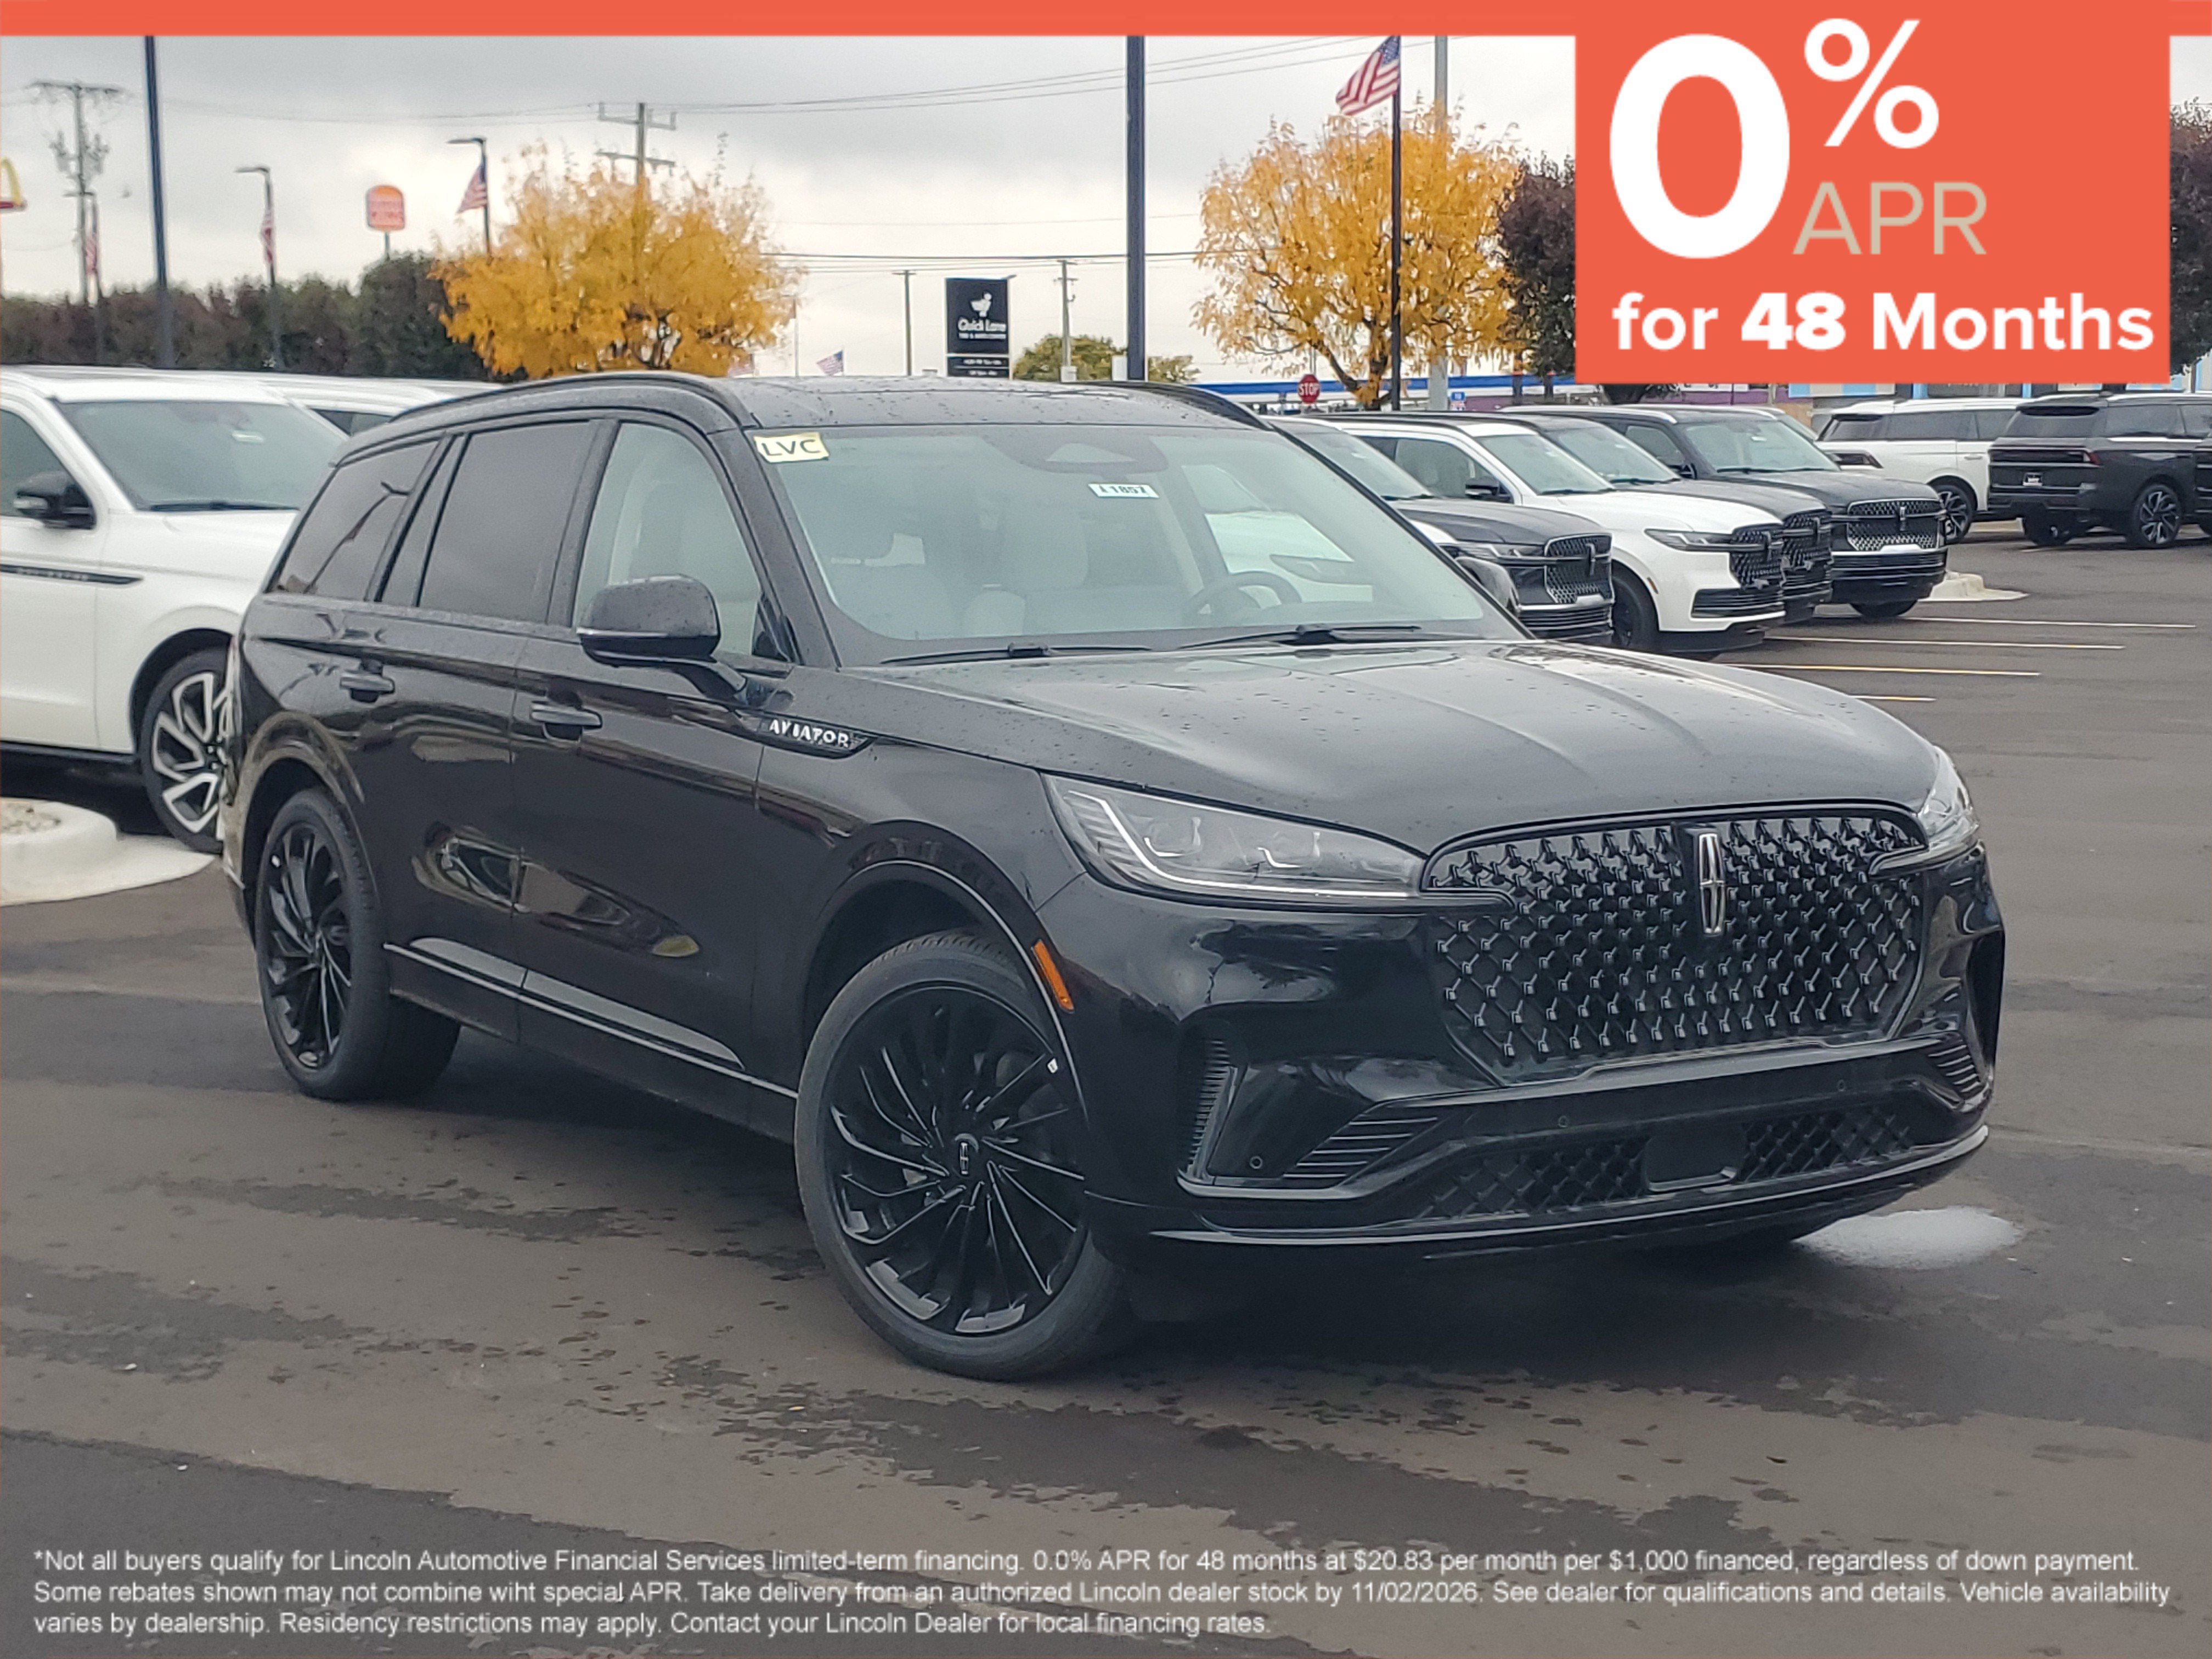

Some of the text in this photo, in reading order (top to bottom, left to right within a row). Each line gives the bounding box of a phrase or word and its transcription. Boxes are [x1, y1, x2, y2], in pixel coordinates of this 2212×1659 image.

[1299, 382, 1319, 396] STOP
[761, 439, 821, 456] LVC
[769, 719, 849, 748] AVIATOR
